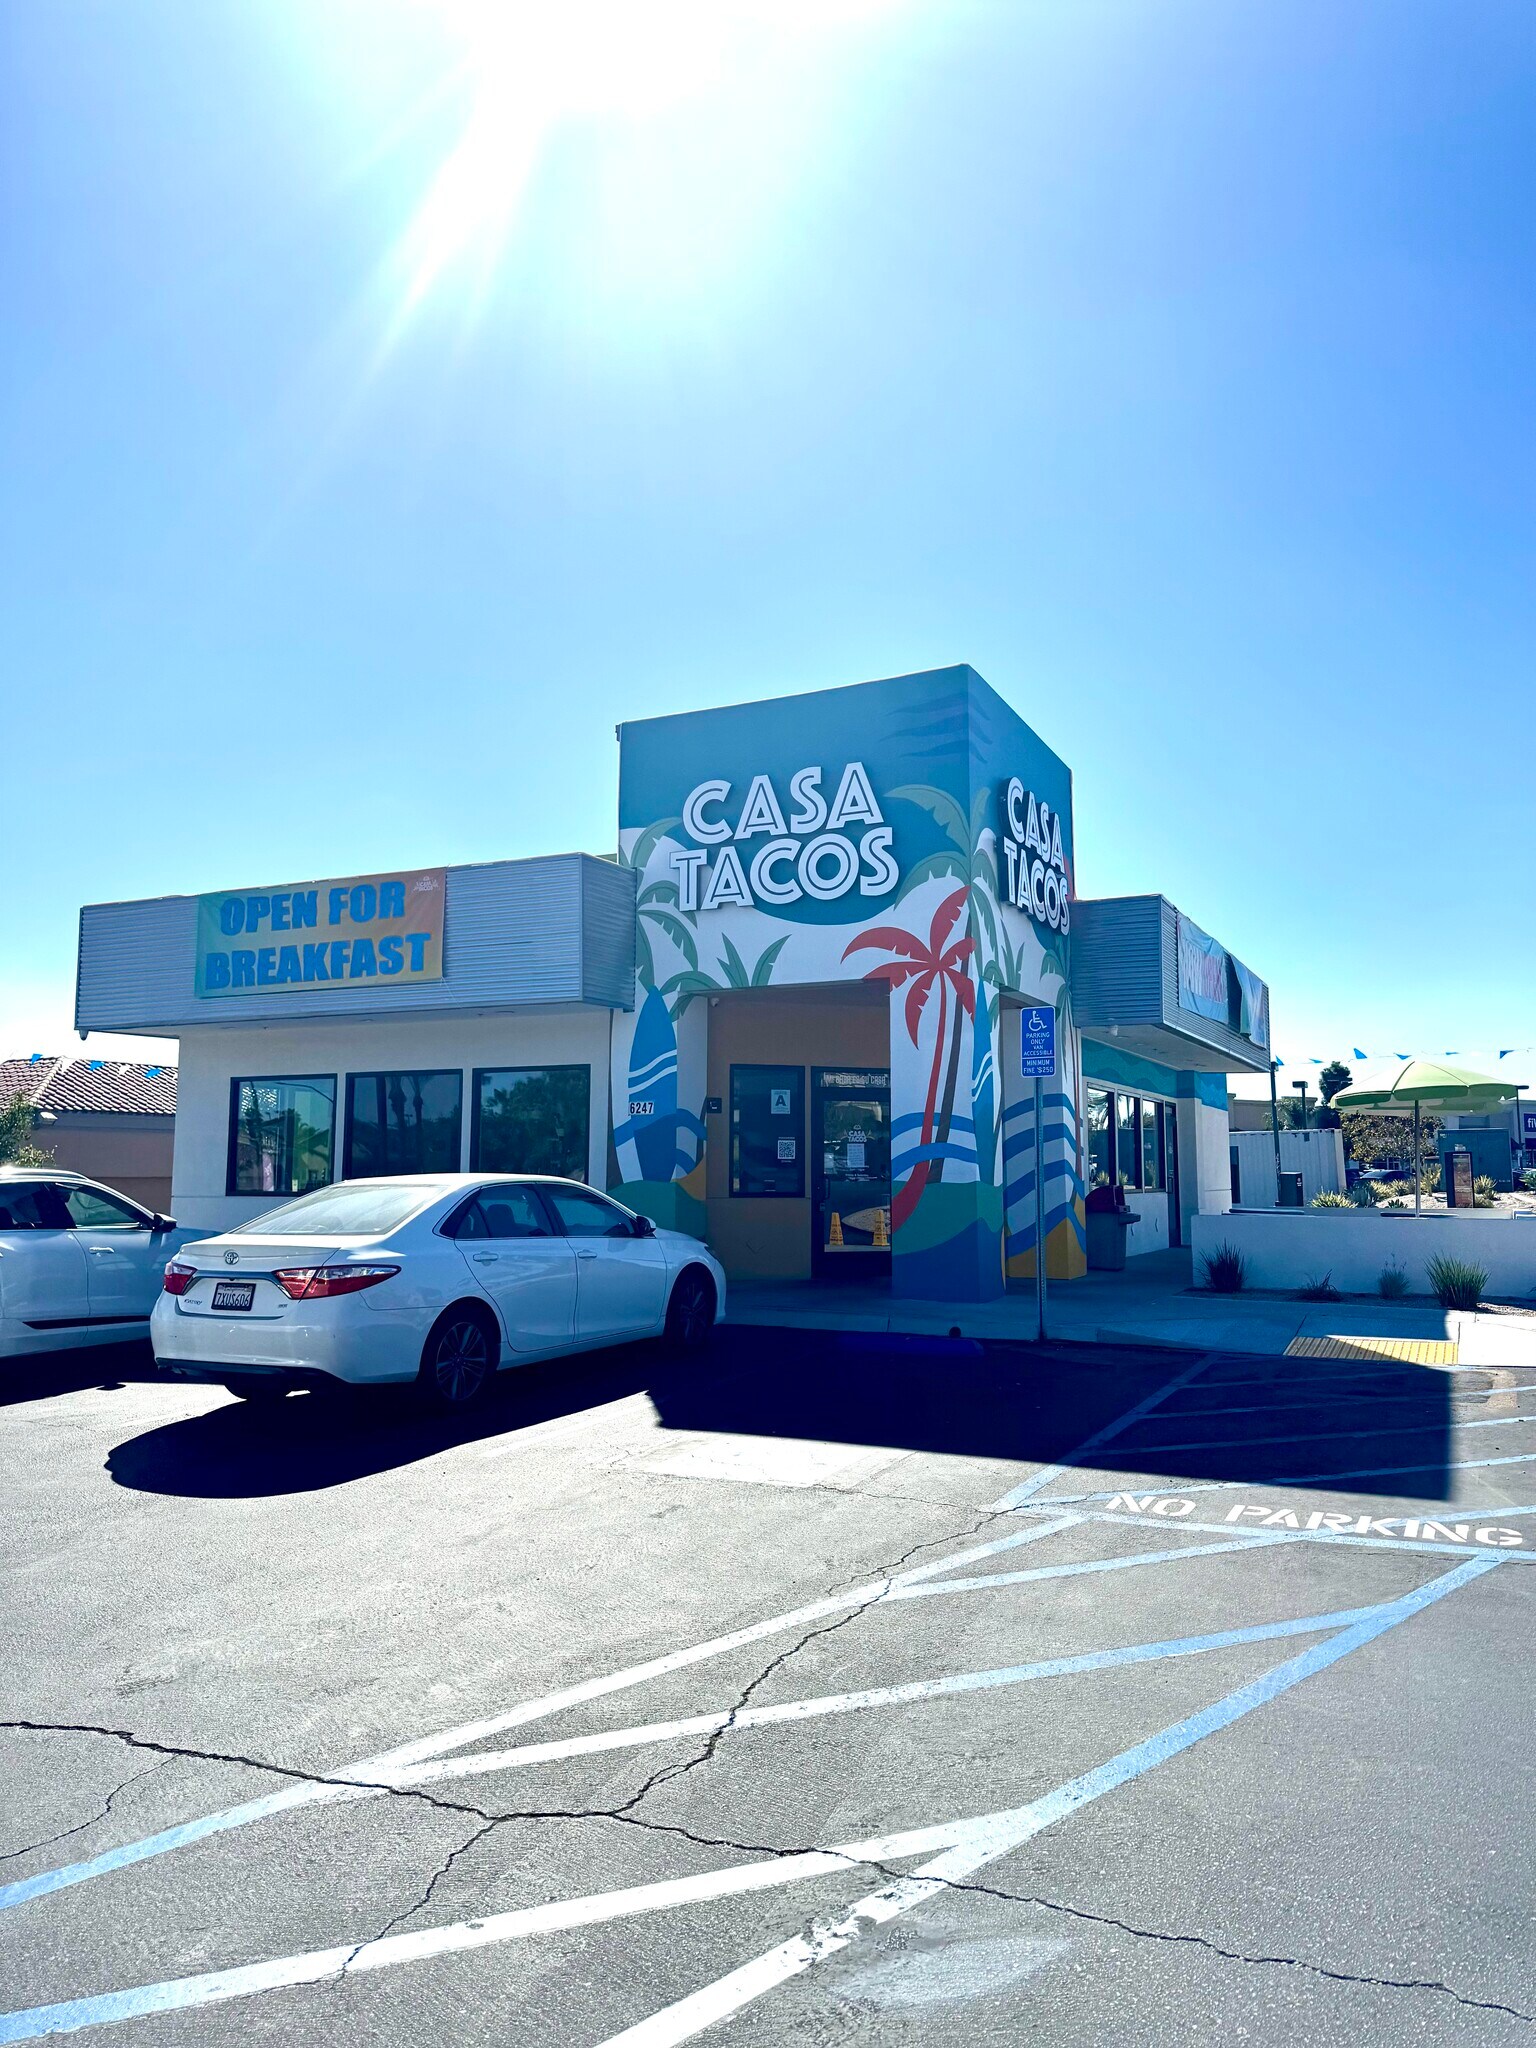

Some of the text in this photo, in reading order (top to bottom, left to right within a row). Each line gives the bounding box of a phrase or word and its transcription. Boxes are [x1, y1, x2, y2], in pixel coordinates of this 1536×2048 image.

[682, 761, 884, 844] CASA
[1007, 776, 1065, 874] CASA
[669, 827, 899, 912] TACOS
[1004, 831, 1070, 936] TACOS
[220, 881, 406, 936] OPEN FOR
[205, 933, 431, 990] BREAKFAST
[630, 1102, 653, 1114] 6247
[775, 1094, 787, 1106] A
[216, 1292, 251, 1306] 7XUS606
[1105, 1491, 1523, 1546] NO PARKING
